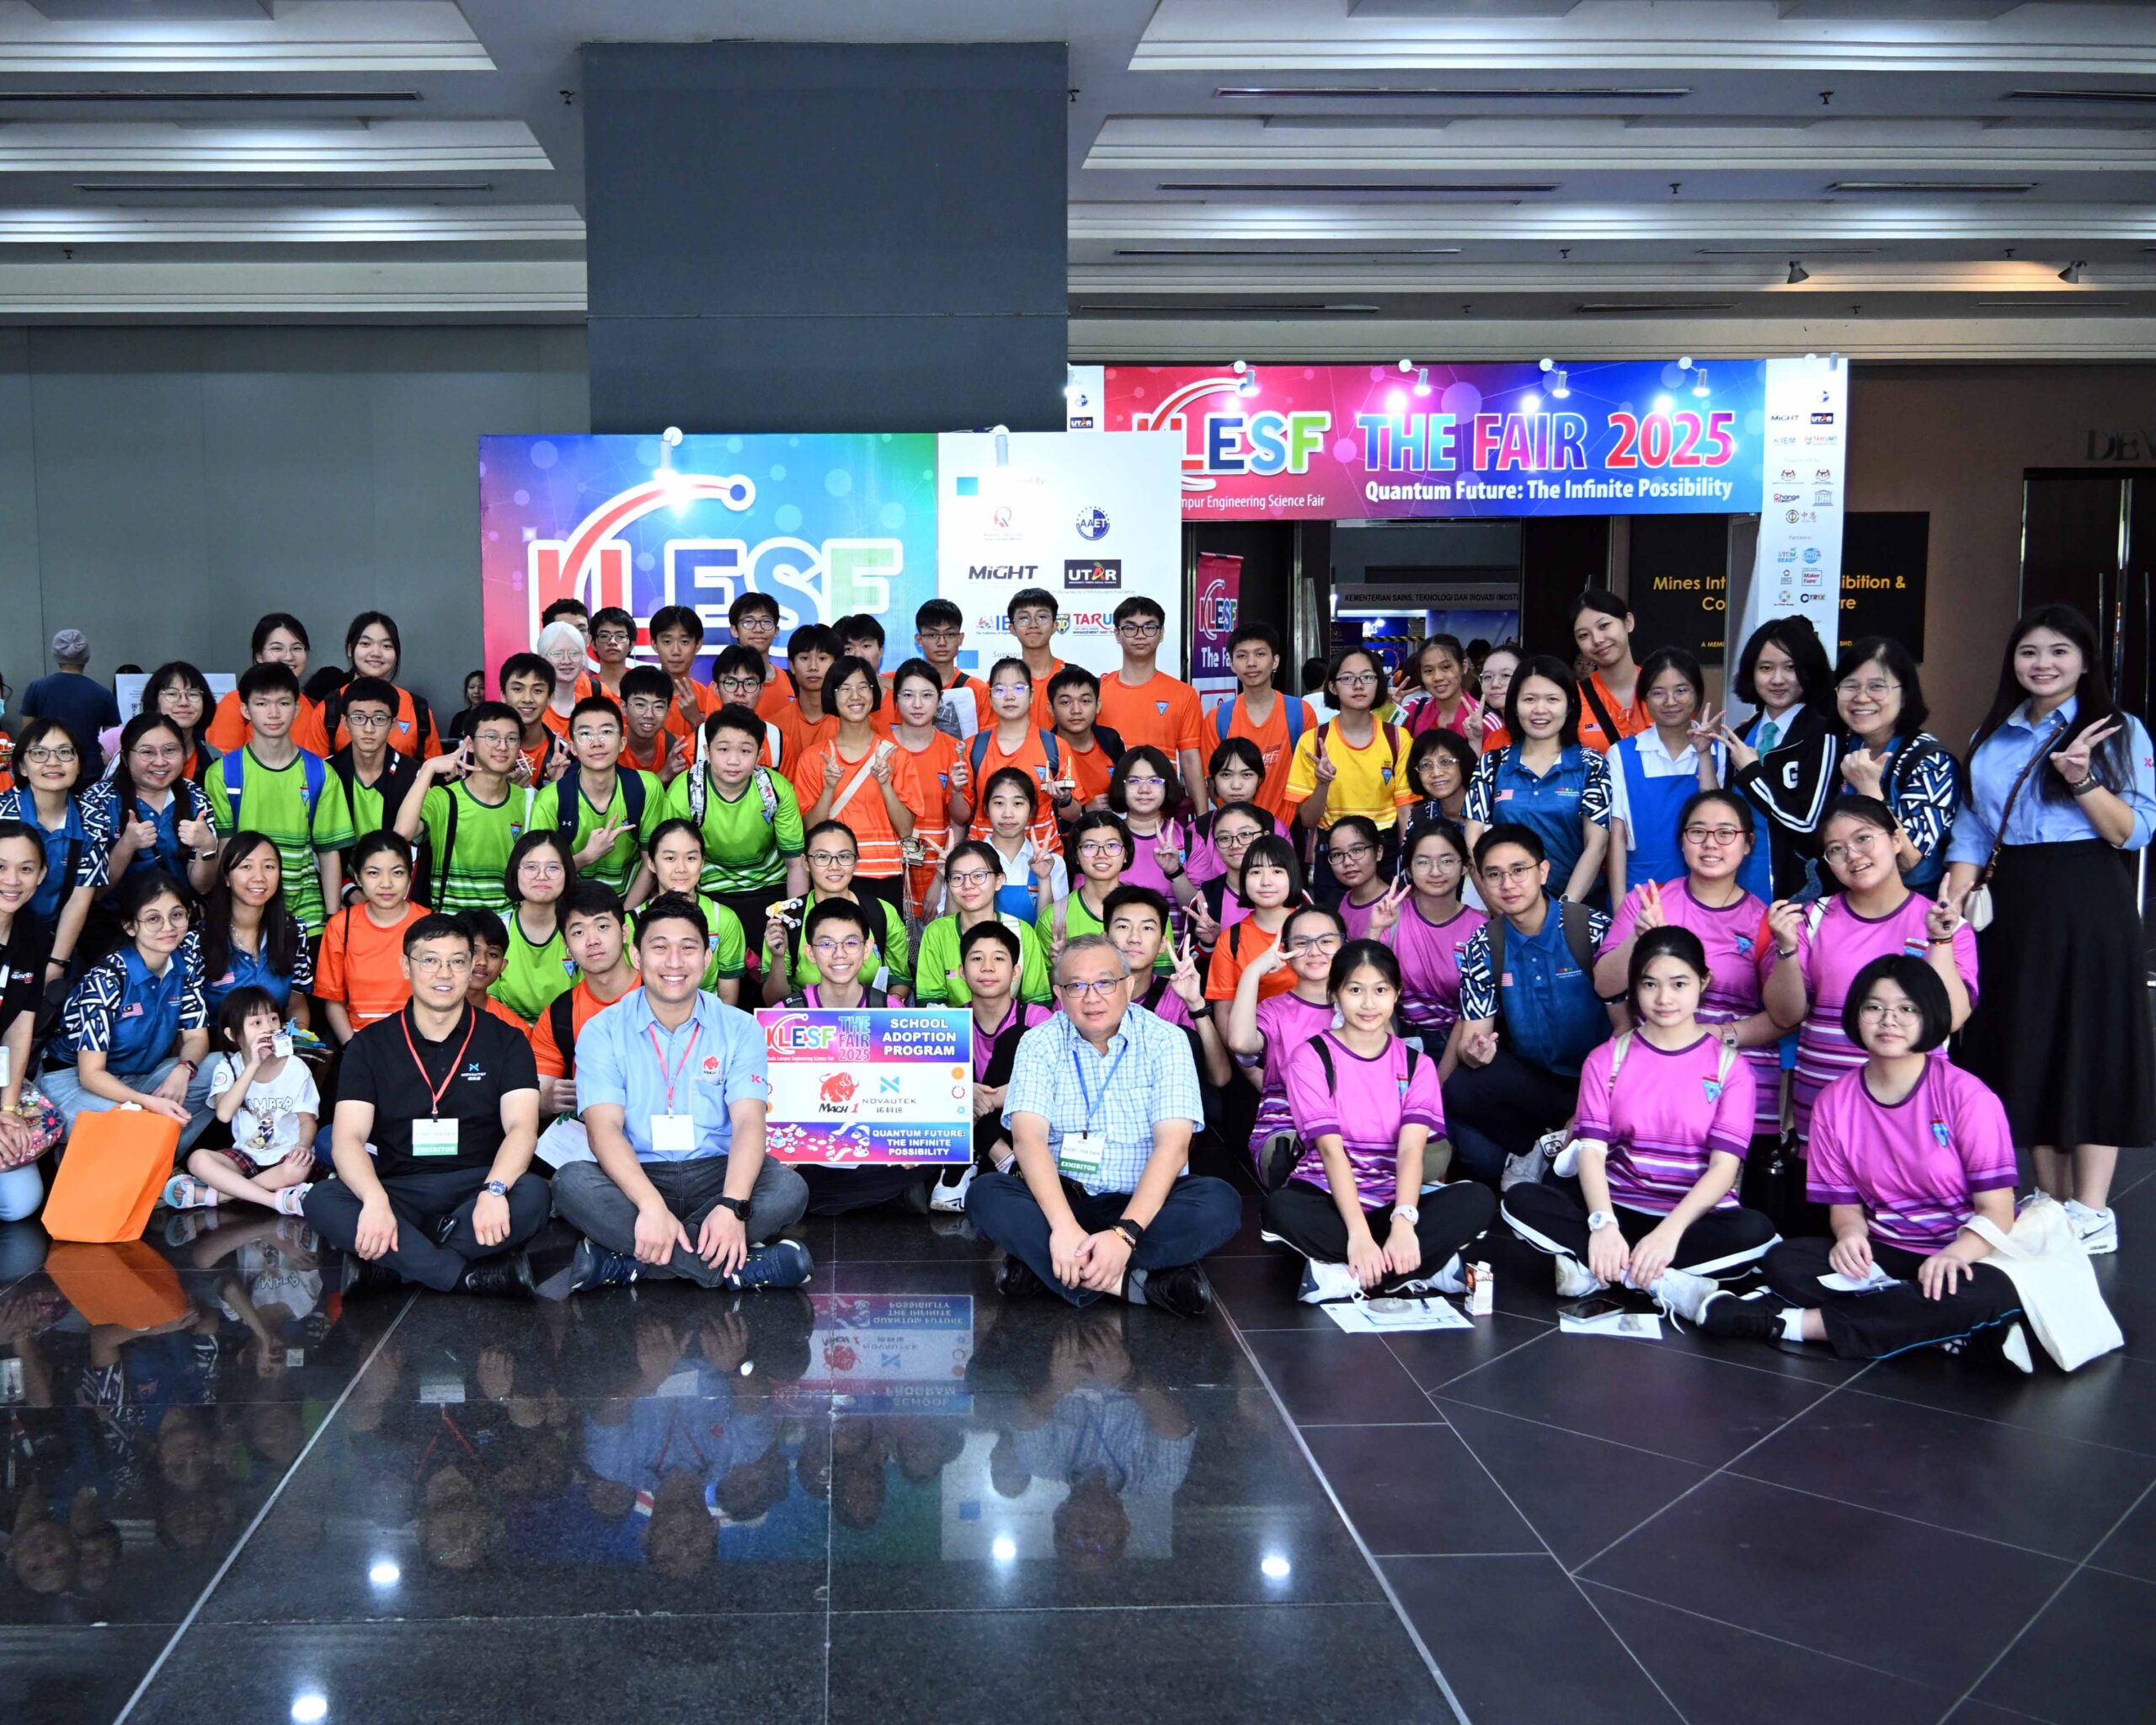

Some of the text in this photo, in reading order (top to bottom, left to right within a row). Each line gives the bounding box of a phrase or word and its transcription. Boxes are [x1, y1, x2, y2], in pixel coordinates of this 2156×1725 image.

[1357, 409, 1737, 472] THE FAIR 2025
[1365, 478, 1733, 502] Quantum Future: The Infinite Possibility
[1181, 494, 1326, 510] mpur Engineering Science Fair
[1068, 566, 1117, 581] UTAR
[1653, 574, 1906, 590] Mines Int ibition &
[1702, 596, 1856, 611] Co re
[1073, 613, 1113, 627] TARU
[1198, 597, 1238, 633] KLESF
[995, 616, 1011, 631] IE
[992, 651, 1021, 660] Suppor
[1201, 646, 1232, 668] The Fa
[1782, 761, 1799, 789] G
[839, 1016, 871, 1033] THE
[889, 1018, 949, 1029] SCHOOL
[766, 1025, 836, 1049] KLESF
[839, 1033, 871, 1048] FAIR
[882, 1032, 957, 1043] ADOPTION
[839, 1049, 870, 1062] 2025
[883, 1045, 956, 1056] PROGRAM
[851, 1103, 859, 1114] 1
[873, 1130, 966, 1138] QUANTUM FUTURE:
[889, 1147, 950, 1156] POSSIBILITY
